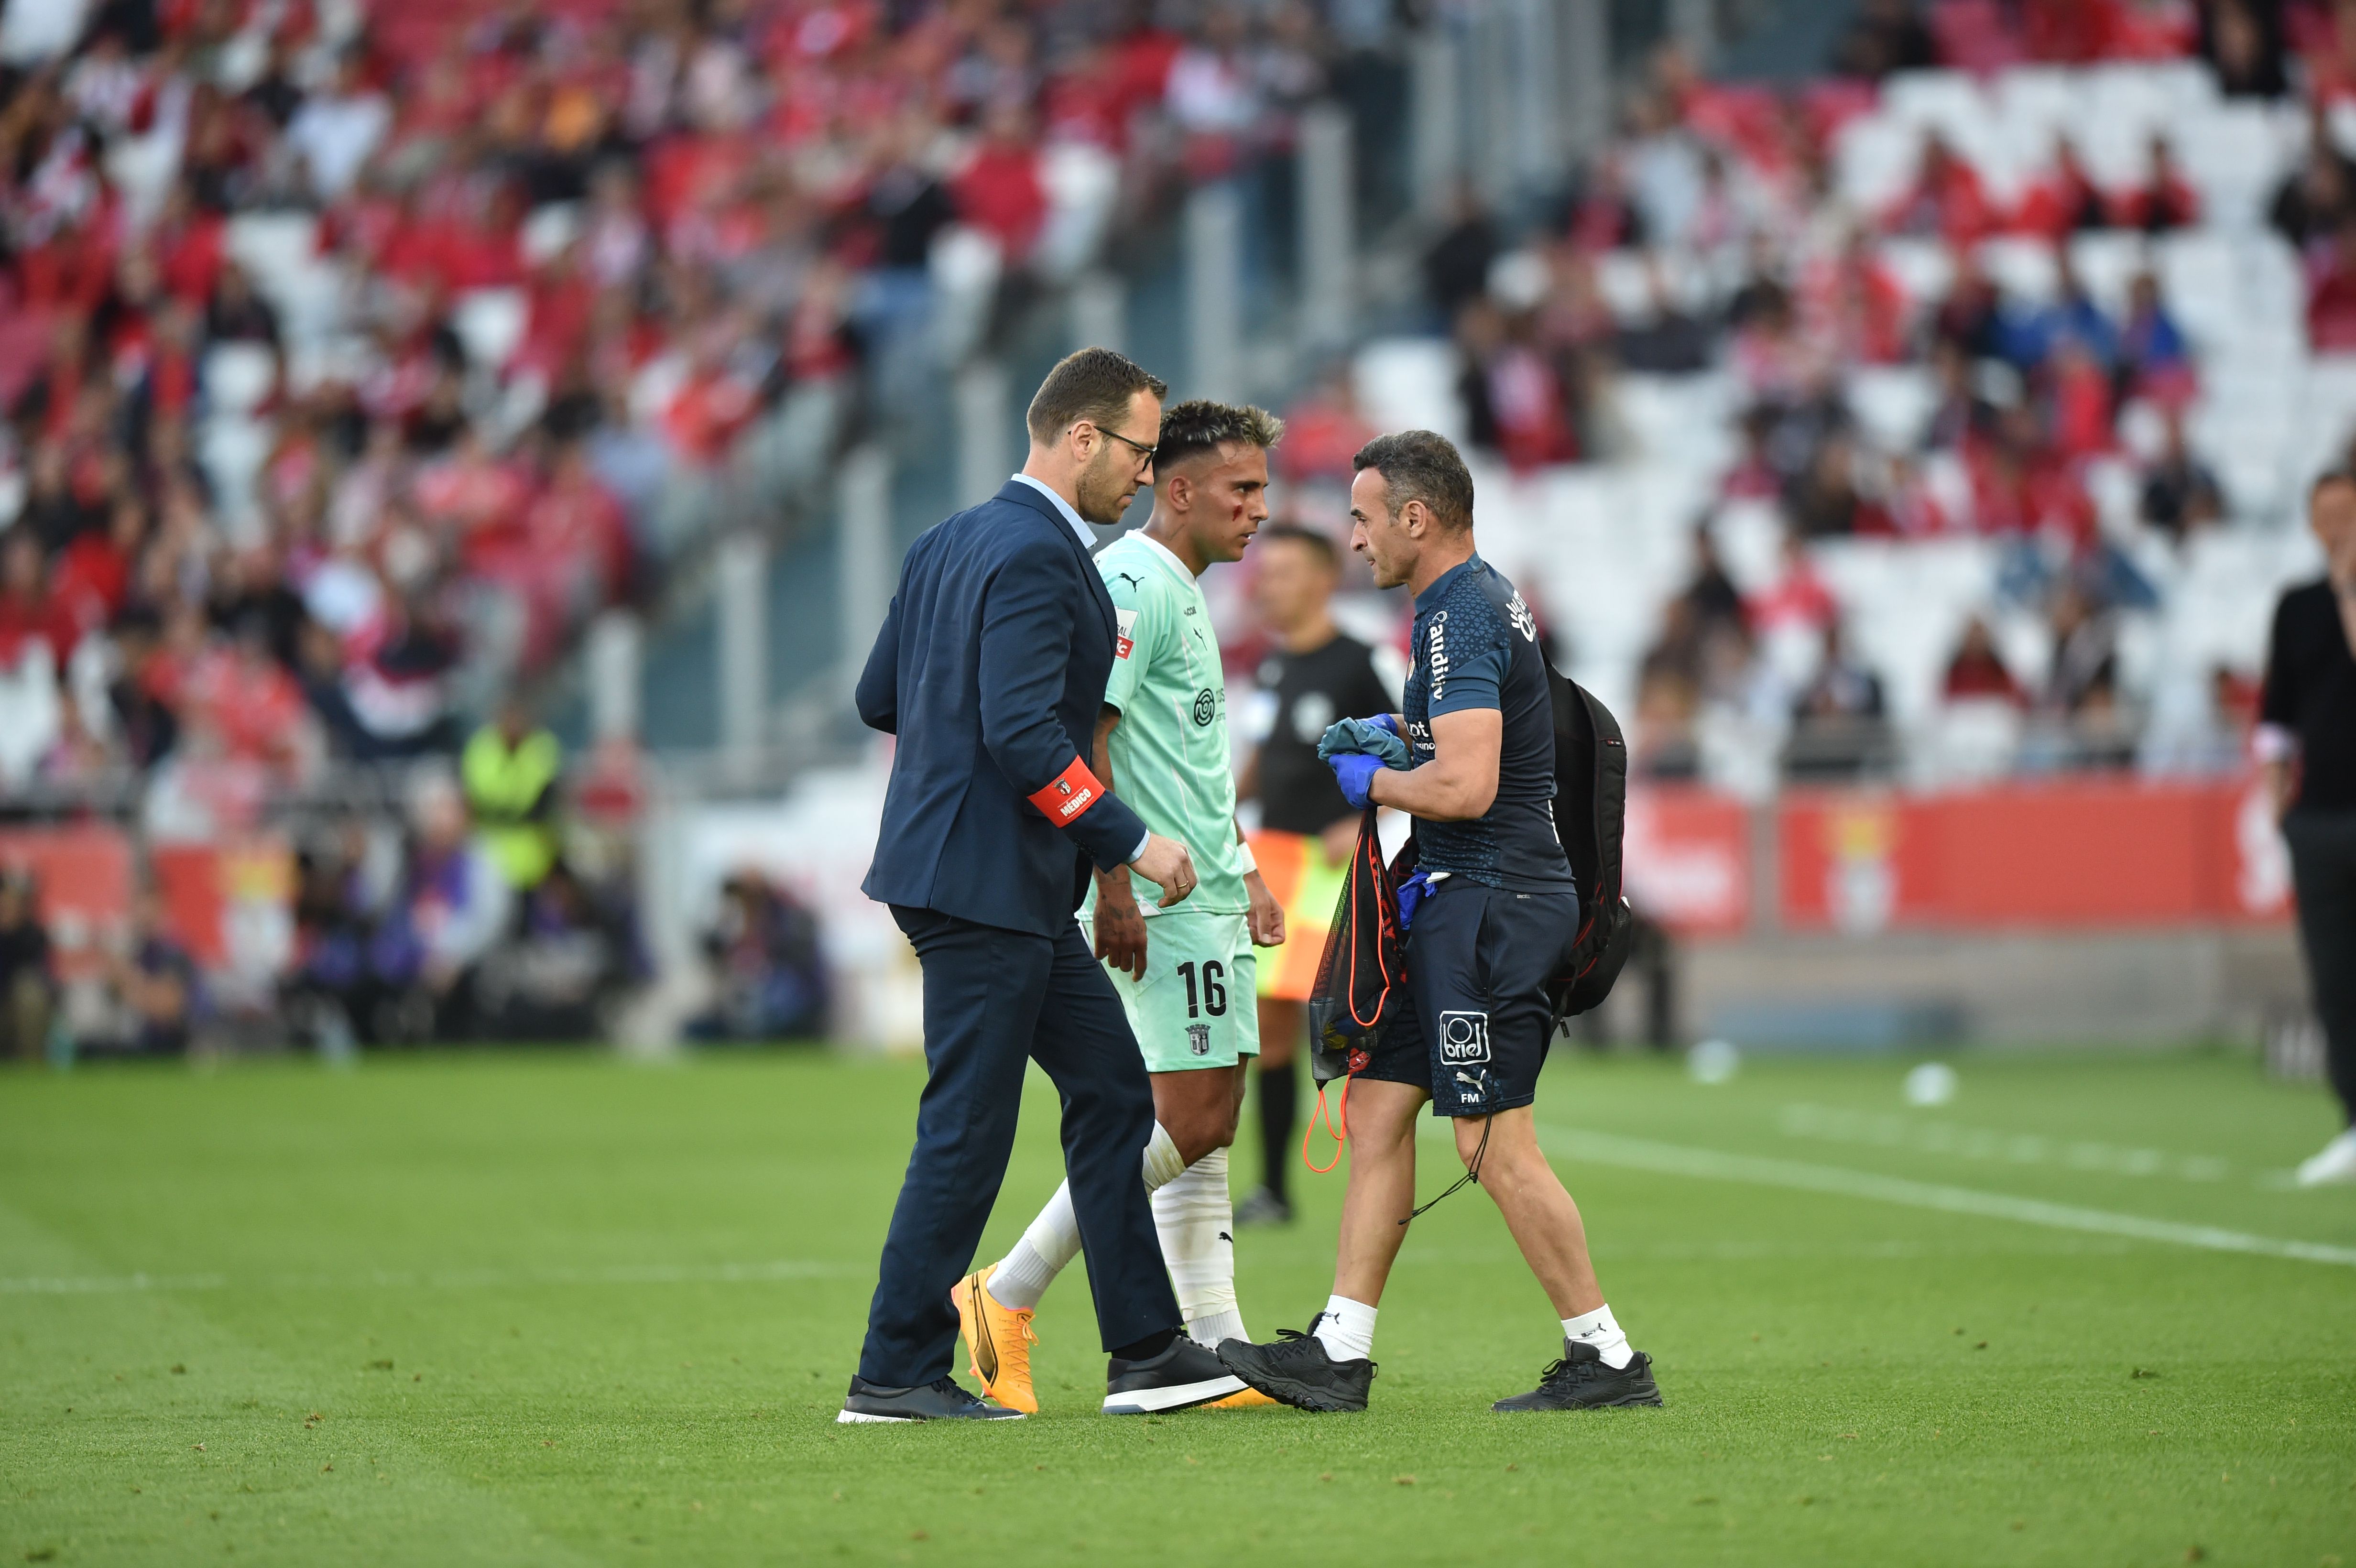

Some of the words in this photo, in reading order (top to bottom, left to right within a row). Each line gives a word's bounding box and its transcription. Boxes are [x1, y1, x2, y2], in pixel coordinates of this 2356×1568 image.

[1060, 788, 1091, 817] MÉDICO
[1177, 960, 1227, 1019] 16
[1461, 1093, 1479, 1103] FM
